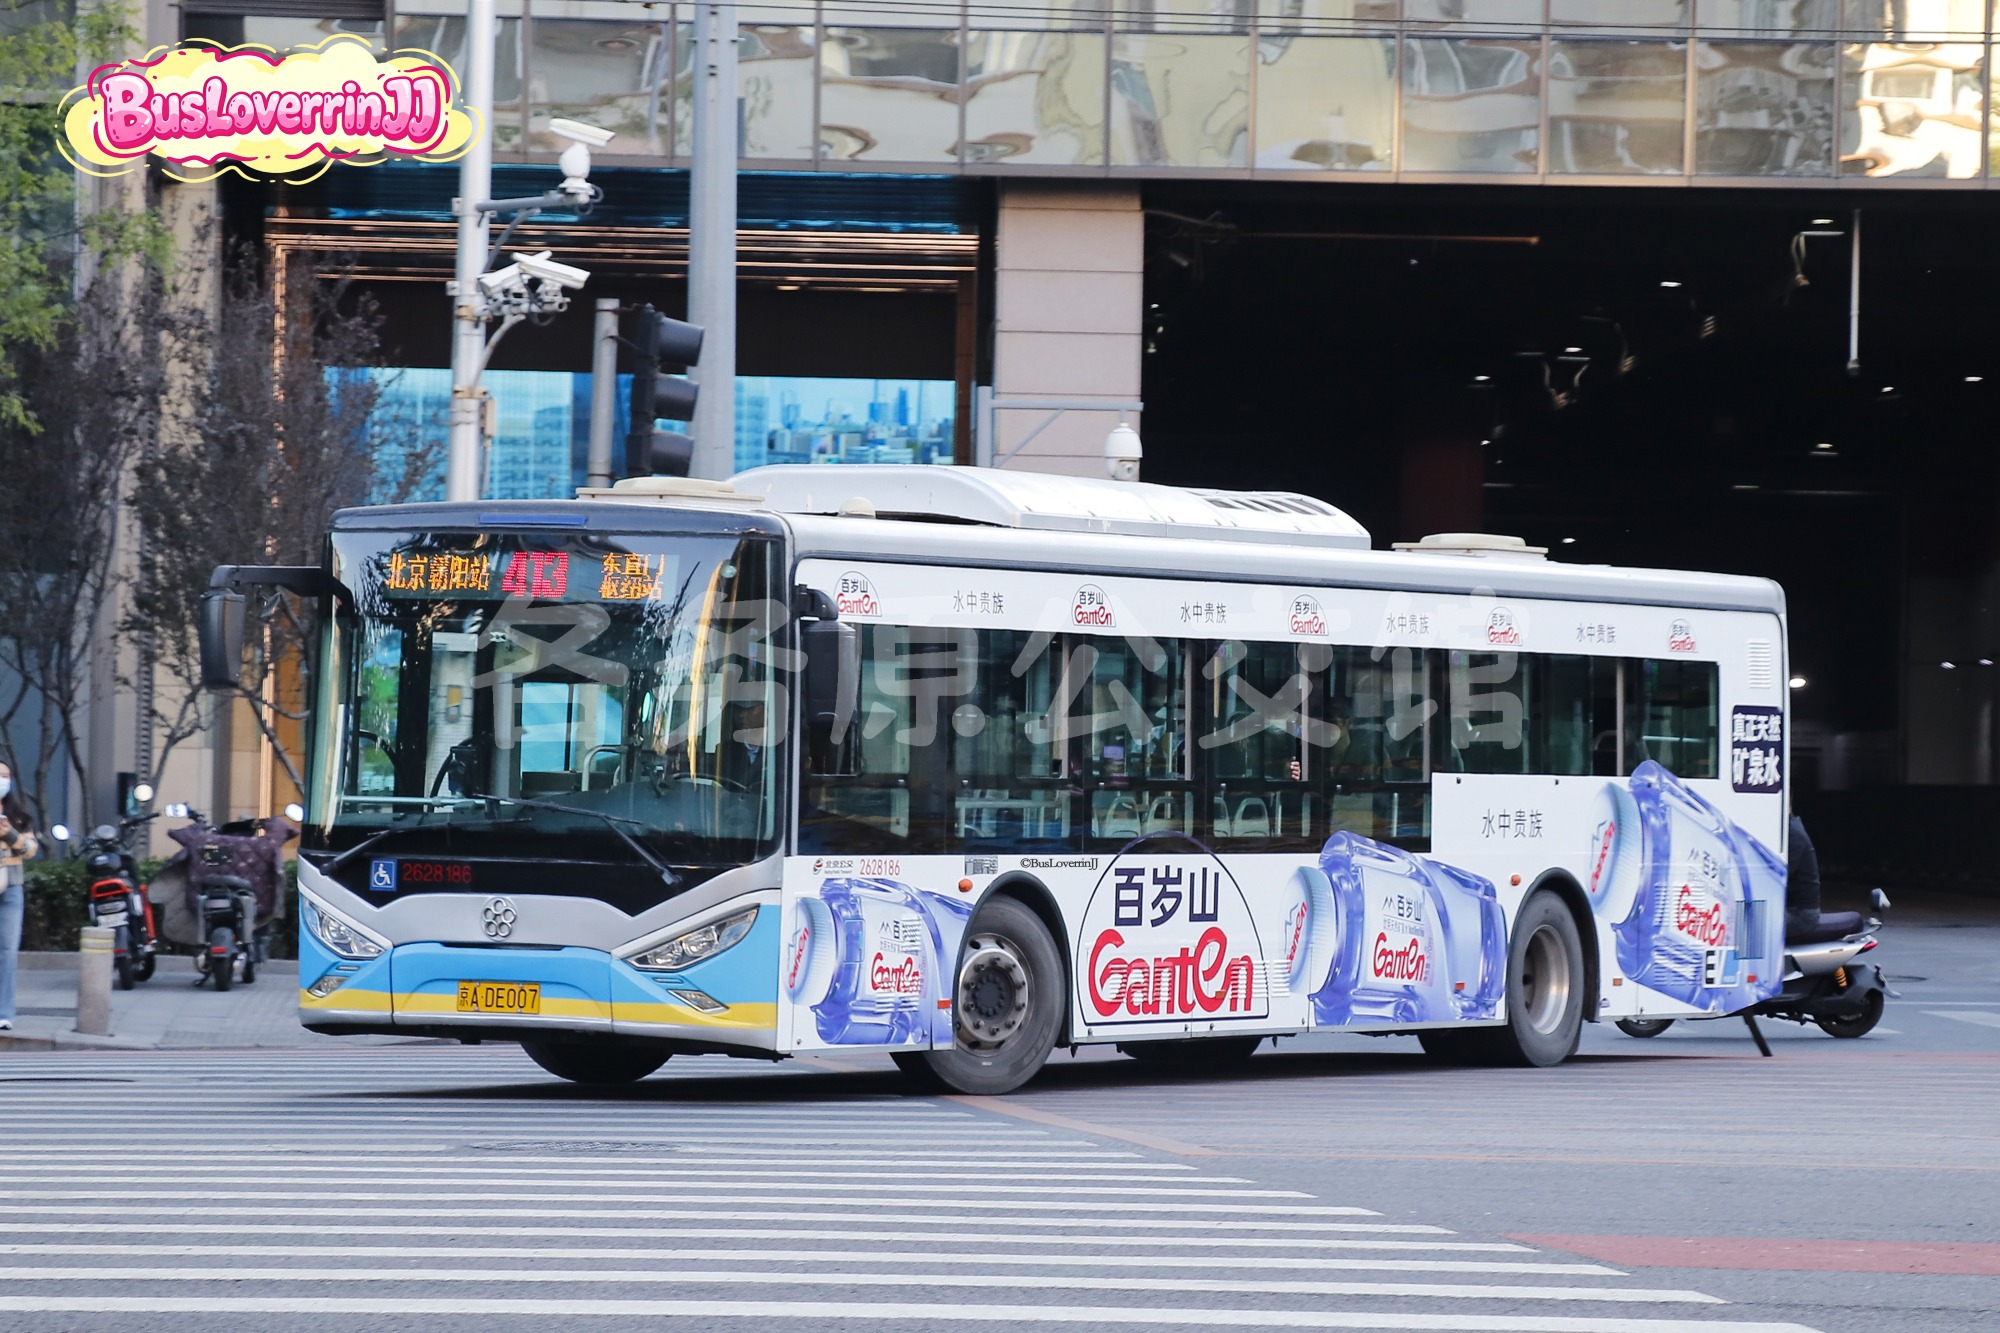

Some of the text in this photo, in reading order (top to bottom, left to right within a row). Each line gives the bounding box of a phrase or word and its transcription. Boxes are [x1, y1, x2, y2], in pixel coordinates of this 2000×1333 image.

[385, 553, 491, 592] 北京朝阳站
[501, 551, 570, 598] 413
[841, 578, 868, 594] 百岁山
[953, 590, 1004, 614] 水中贵族
[1079, 591, 1104, 605] 百岁山
[1295, 601, 1318, 615] 百岁山
[1180, 601, 1227, 624] 水中贵族
[1386, 613, 1430, 635] 水中贵族
[1576, 622, 1616, 643] 水中贵族
[1733, 712, 1781, 742] 真正天然
[1733, 746, 1781, 786] 矿泉水
[1481, 808, 1543, 838] 水中贵族
[402, 863, 473, 883] 2628186
[860, 859, 900, 876] 2628186
[1114, 865, 1220, 927] 百岁山
[1397, 894, 1422, 922] 百岁山
